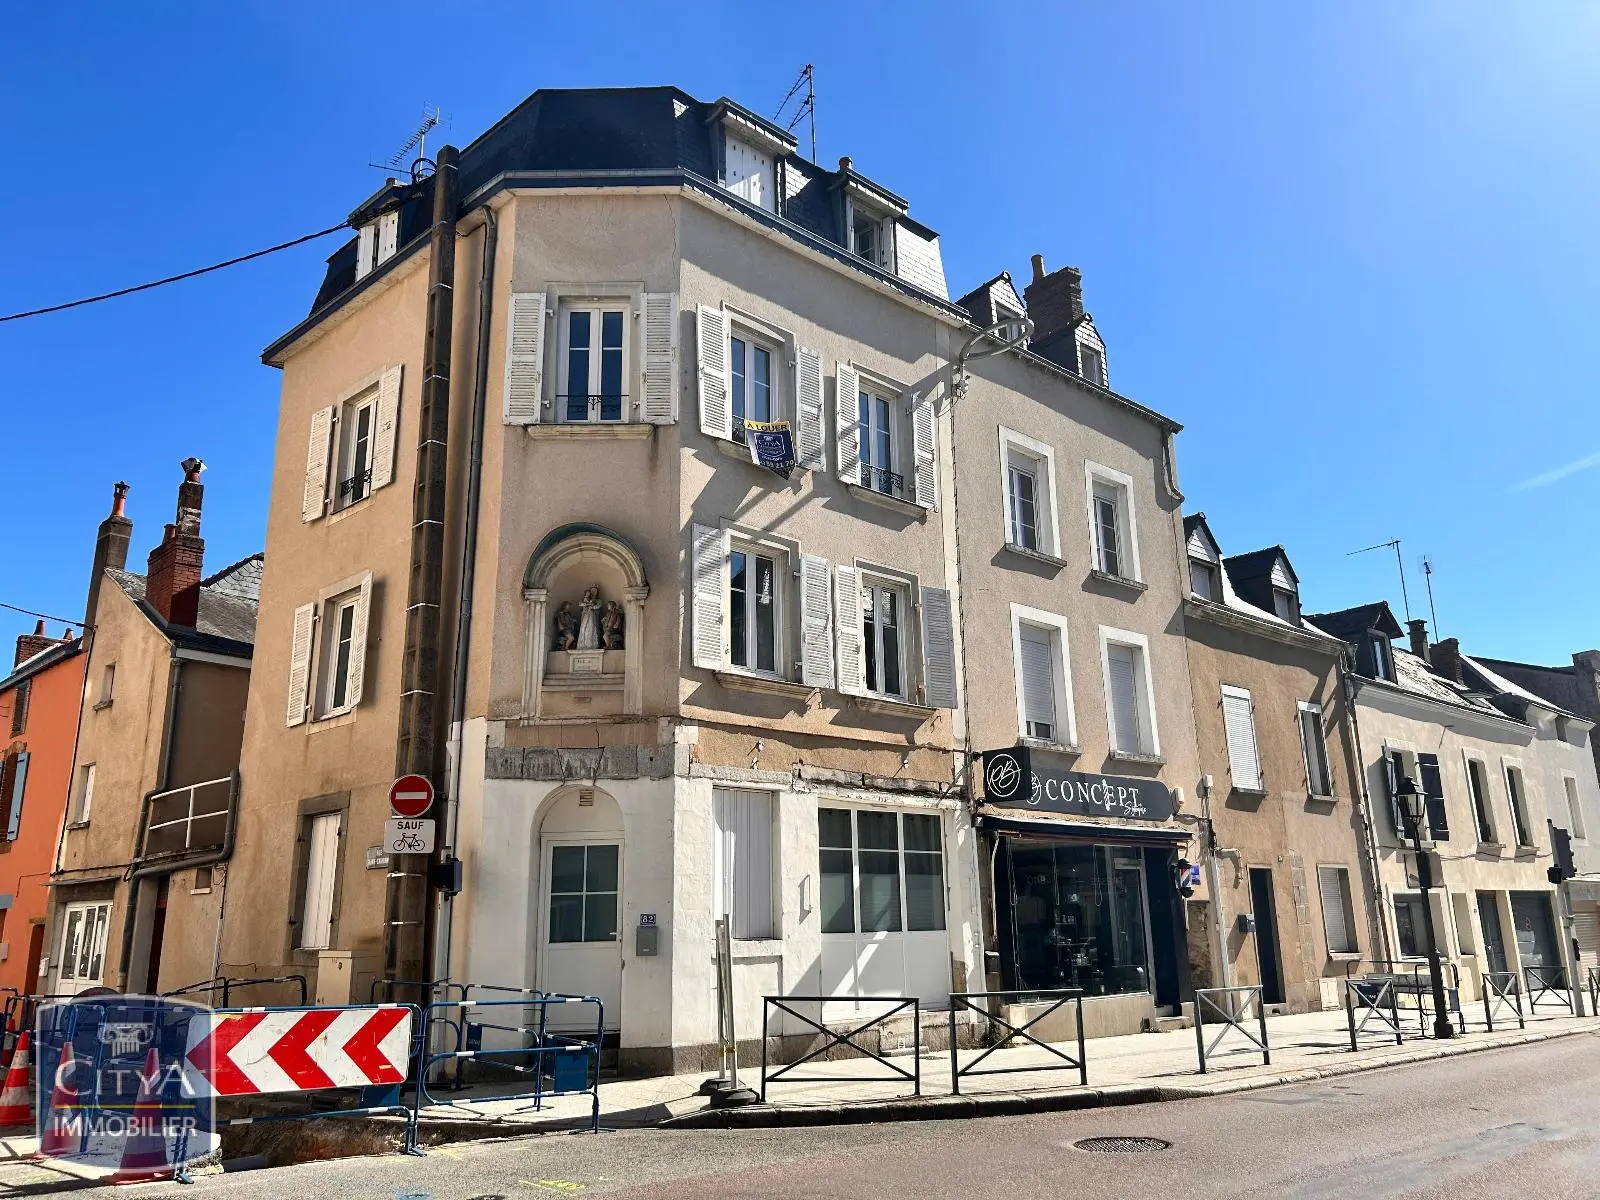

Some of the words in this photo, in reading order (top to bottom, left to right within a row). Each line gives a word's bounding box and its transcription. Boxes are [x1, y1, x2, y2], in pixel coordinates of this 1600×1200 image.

[756, 424, 787, 432] LOUER
[1045, 779, 1139, 808] CONCEPT
[397, 821, 425, 830] SAUF
